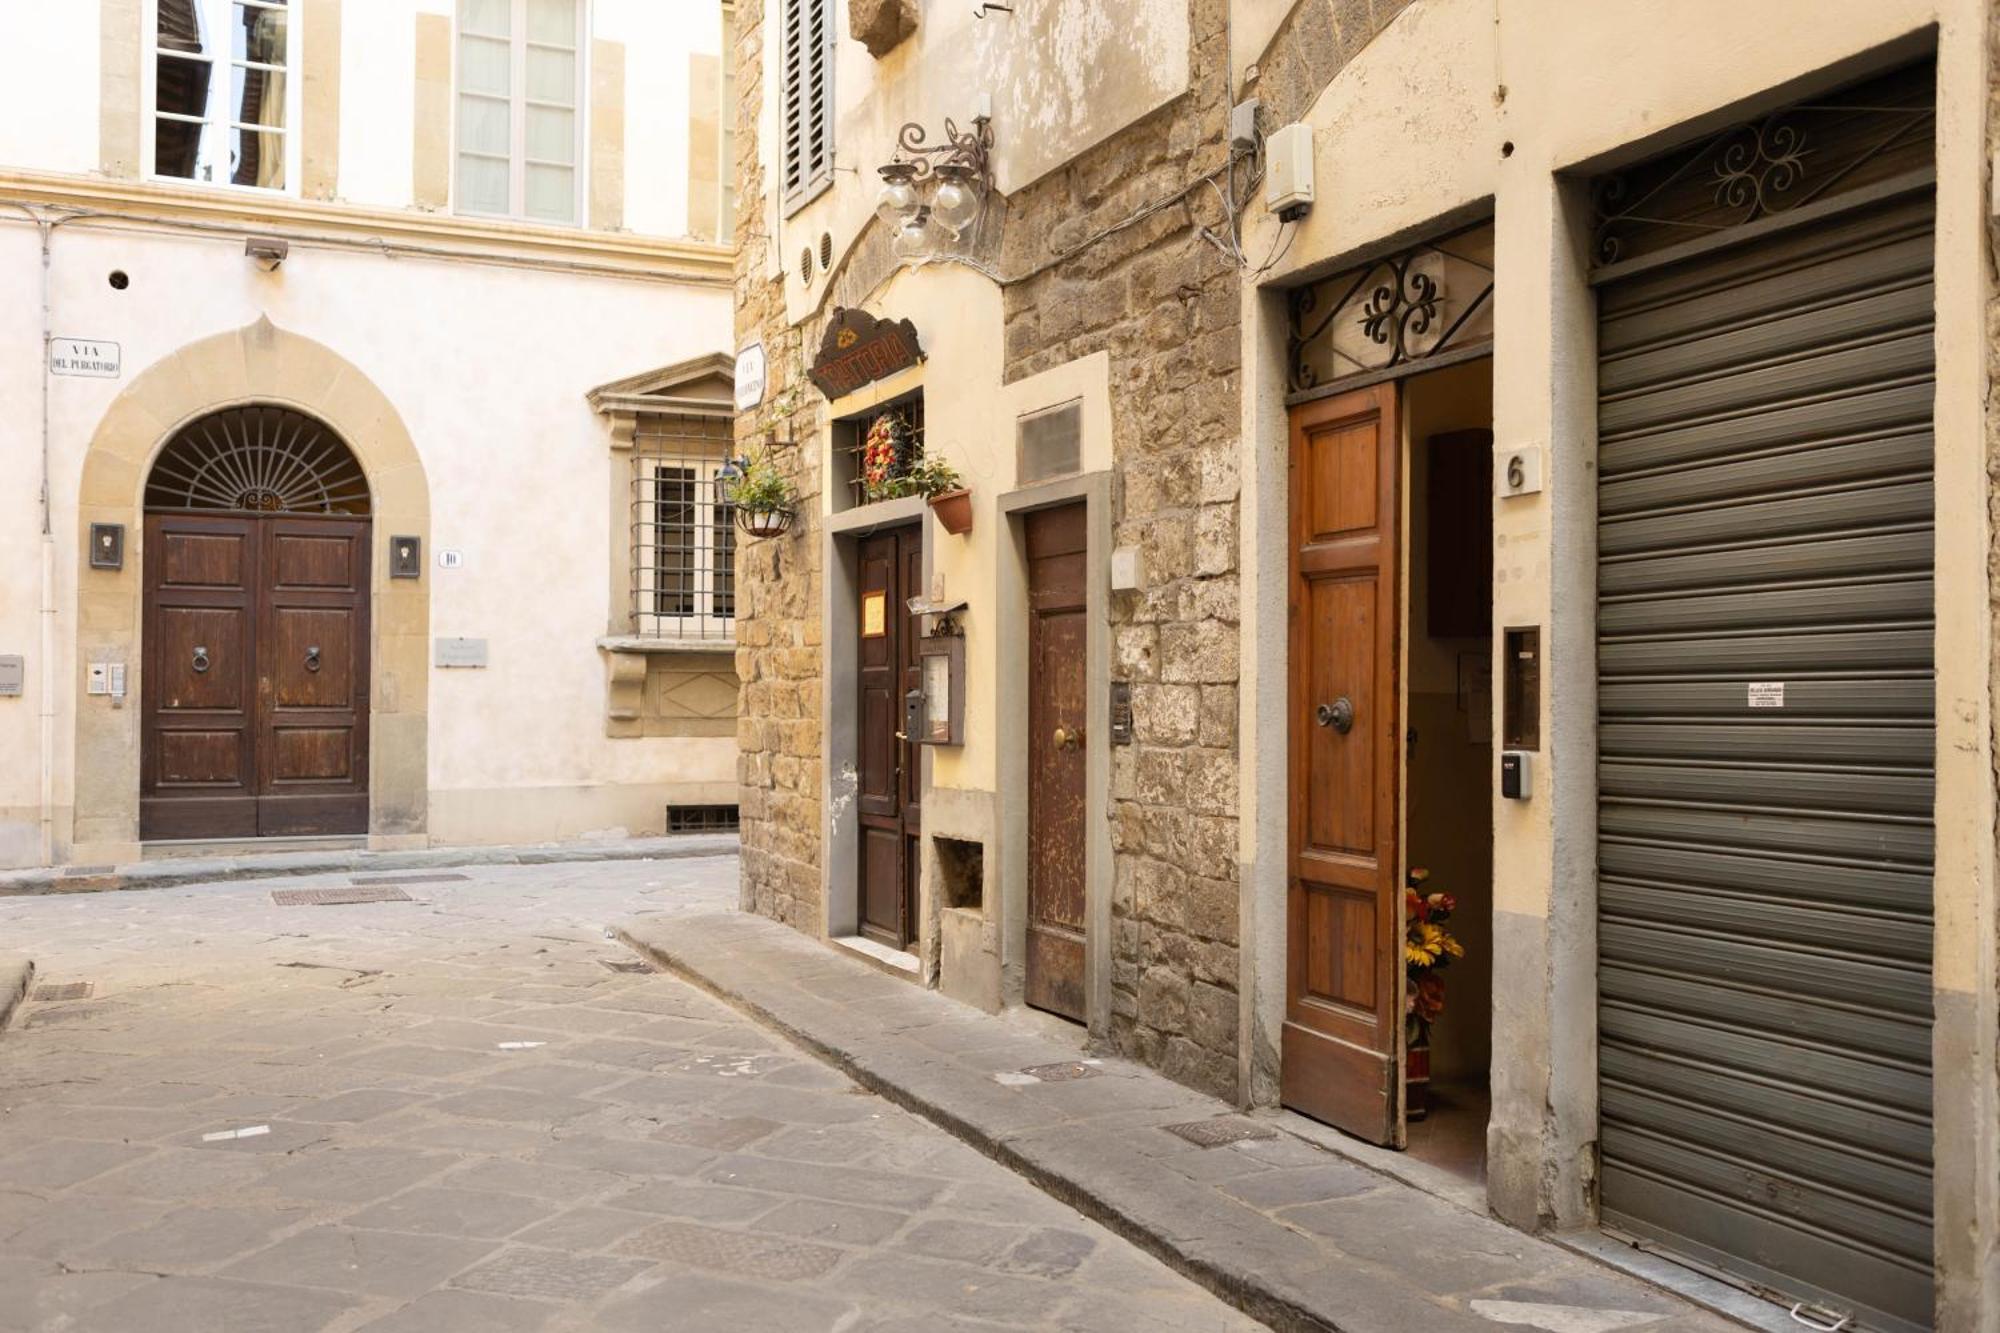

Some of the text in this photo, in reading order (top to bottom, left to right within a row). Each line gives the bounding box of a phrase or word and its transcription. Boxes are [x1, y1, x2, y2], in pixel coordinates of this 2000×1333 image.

[72, 344, 99, 356] VIA
[815, 332, 912, 389] TRATTORIA
[52, 358, 119, 371] DEL PURGATORIO
[1507, 455, 1525, 489] 6
